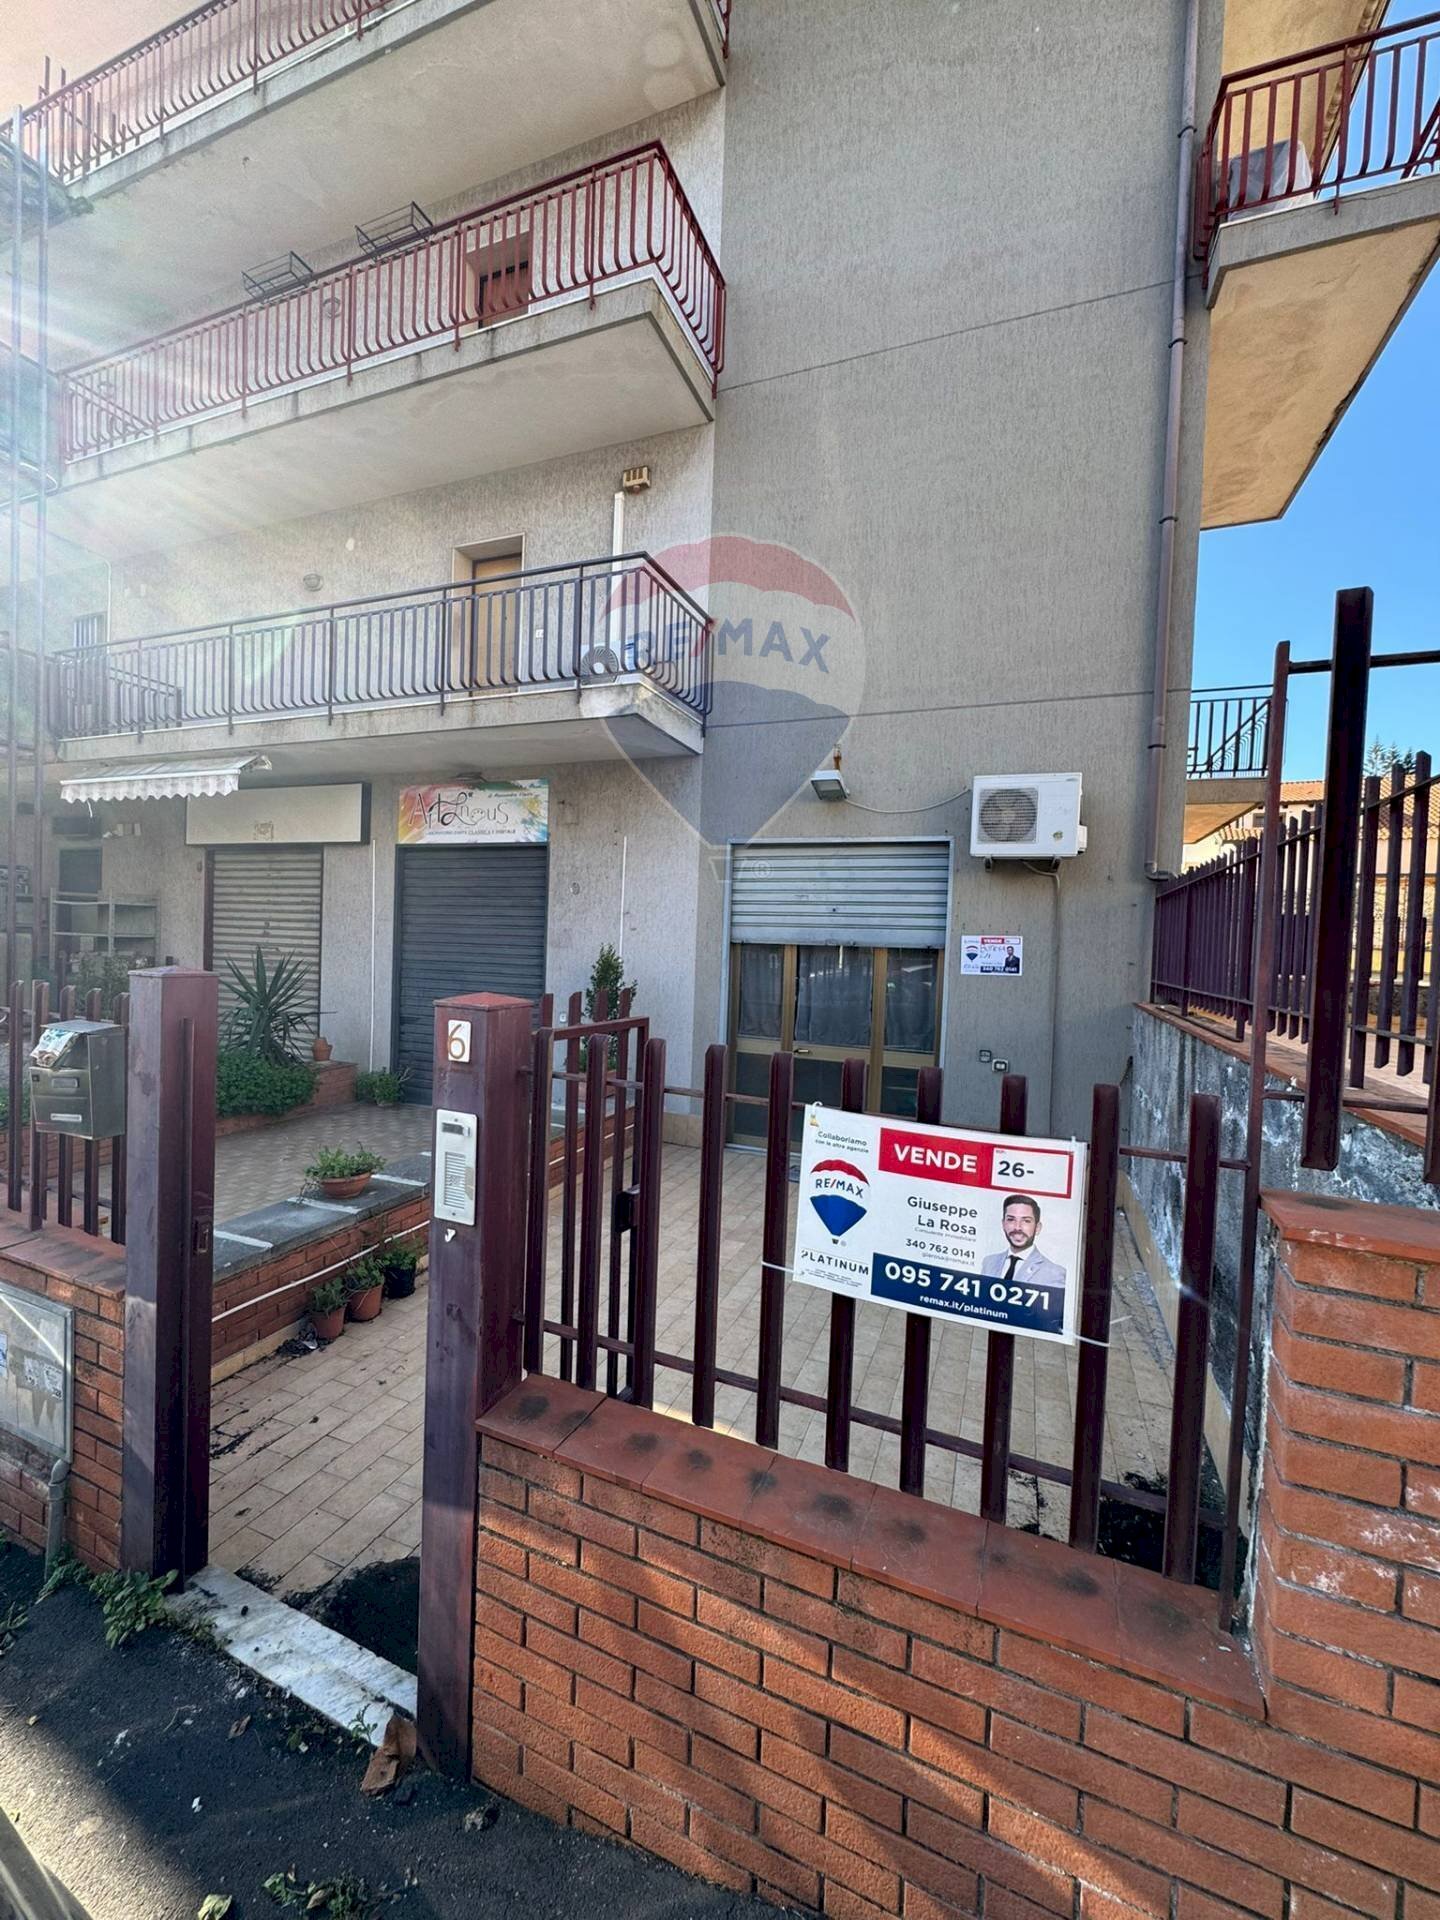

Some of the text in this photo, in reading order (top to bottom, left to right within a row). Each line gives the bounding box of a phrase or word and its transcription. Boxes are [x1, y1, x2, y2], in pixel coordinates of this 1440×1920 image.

[447, 1023, 465, 1059] 6
[817, 1130, 868, 1147] Collaboriamo
[893, 1143, 978, 1173] VENDE
[997, 1160, 1034, 1178] 26-
[815, 1177, 864, 1199] RE/MAX
[907, 1196, 978, 1219] Giuseppe
[917, 1215, 977, 1236] La Rosa
[905, 1238, 976, 1260] 340 762 0141
[885, 1262, 931, 1287] 095
[940, 1273, 982, 1298] 741
[990, 1284, 1050, 1310] 0271
[919, 1294, 1009, 1319] remax.it/platinum
